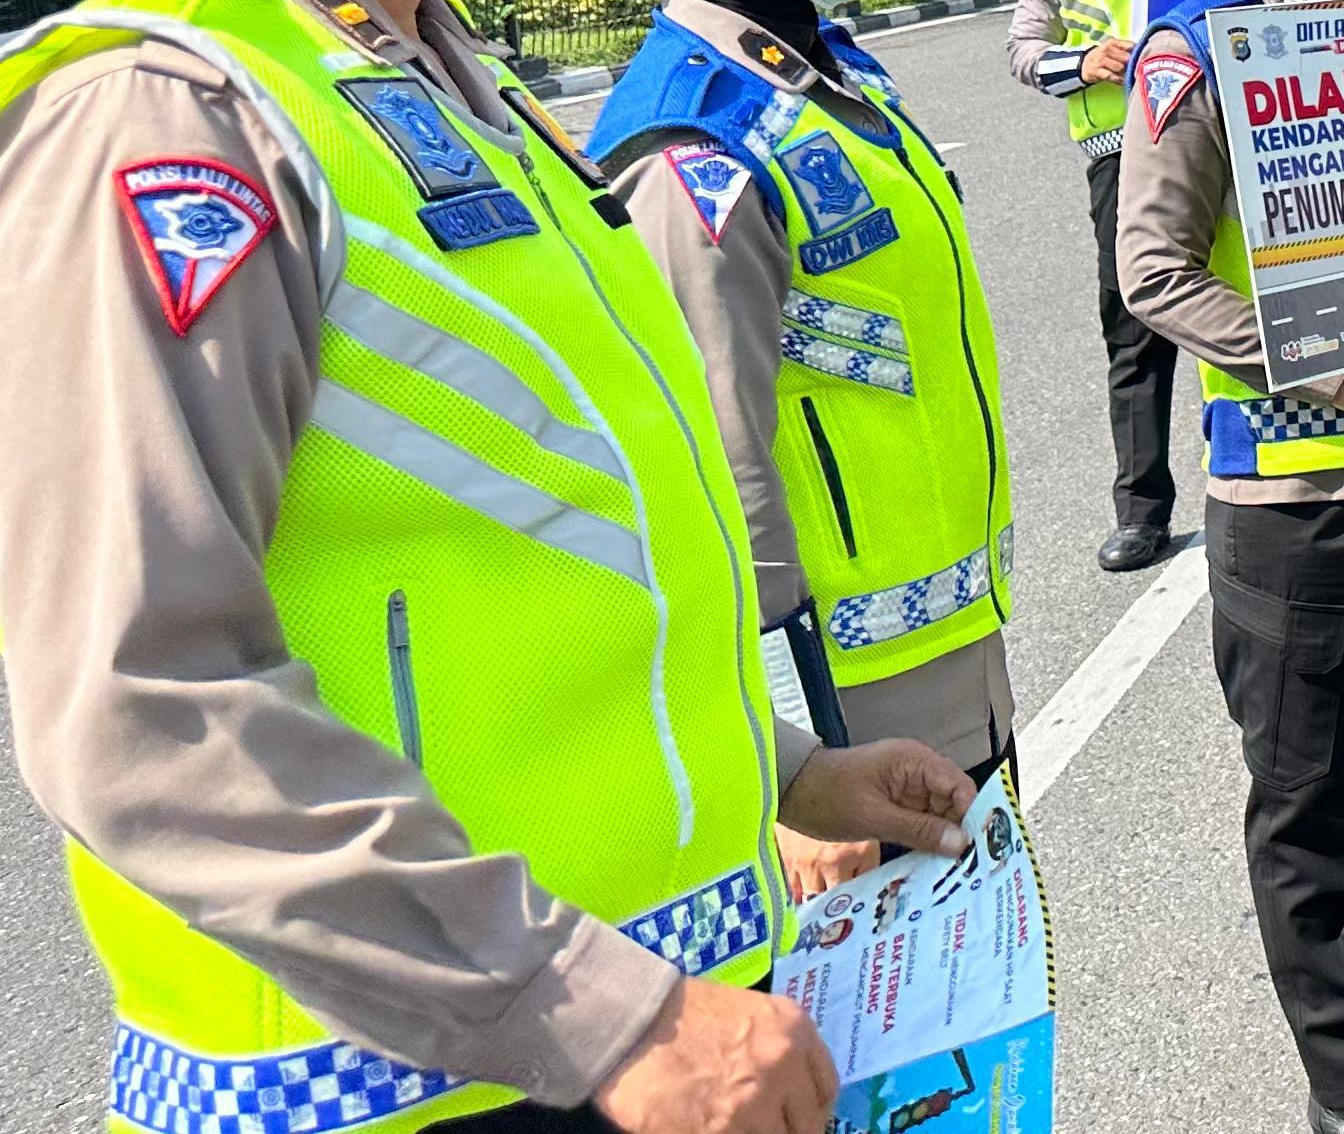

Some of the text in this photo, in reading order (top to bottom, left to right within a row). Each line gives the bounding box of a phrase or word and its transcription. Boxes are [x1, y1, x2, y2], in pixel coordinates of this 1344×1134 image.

[952, 909, 967, 953] TIDAK
[1013, 868, 1027, 948] DILARANG
[866, 941, 887, 1014] DILARANG
[882, 933, 906, 1034] BAK TERBUKA
